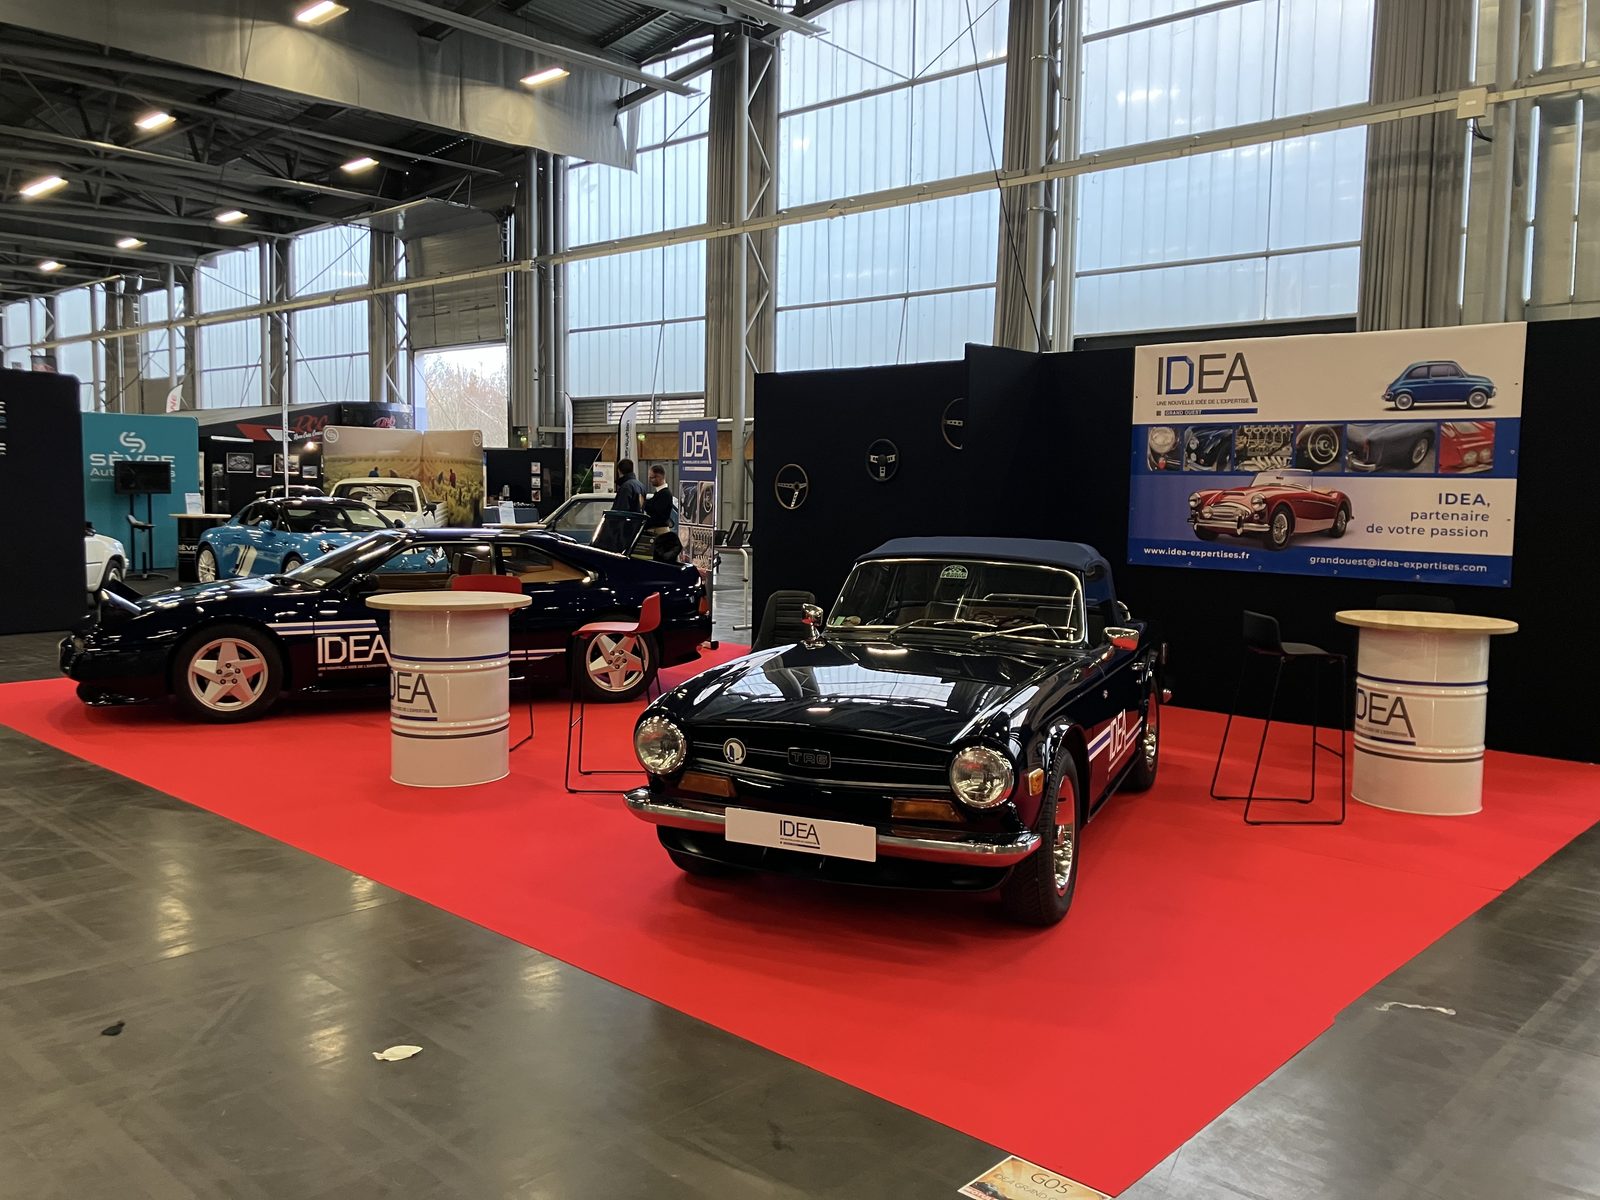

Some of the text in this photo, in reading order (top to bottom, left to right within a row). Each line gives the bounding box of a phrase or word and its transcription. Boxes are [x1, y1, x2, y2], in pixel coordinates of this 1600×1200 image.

[1157, 352, 1258, 402] IDEA
[683, 430, 711, 464] IDEA
[1438, 493, 1490, 507] IDEA,
[1410, 510, 1490, 522] partenaire
[1366, 523, 1489, 538] de votre passion
[1143, 547, 1250, 559] www.idea-expertises.fr
[1309, 555, 1488, 573] grandouest@idea-expertises.com
[317, 634, 391, 666] IDEA
[390, 670, 437, 713] DEA
[1356, 688, 1416, 738] DEA
[1109, 708, 1127, 761] IDEA
[791, 751, 828, 766] TR6
[779, 819, 820, 845] IDEA
